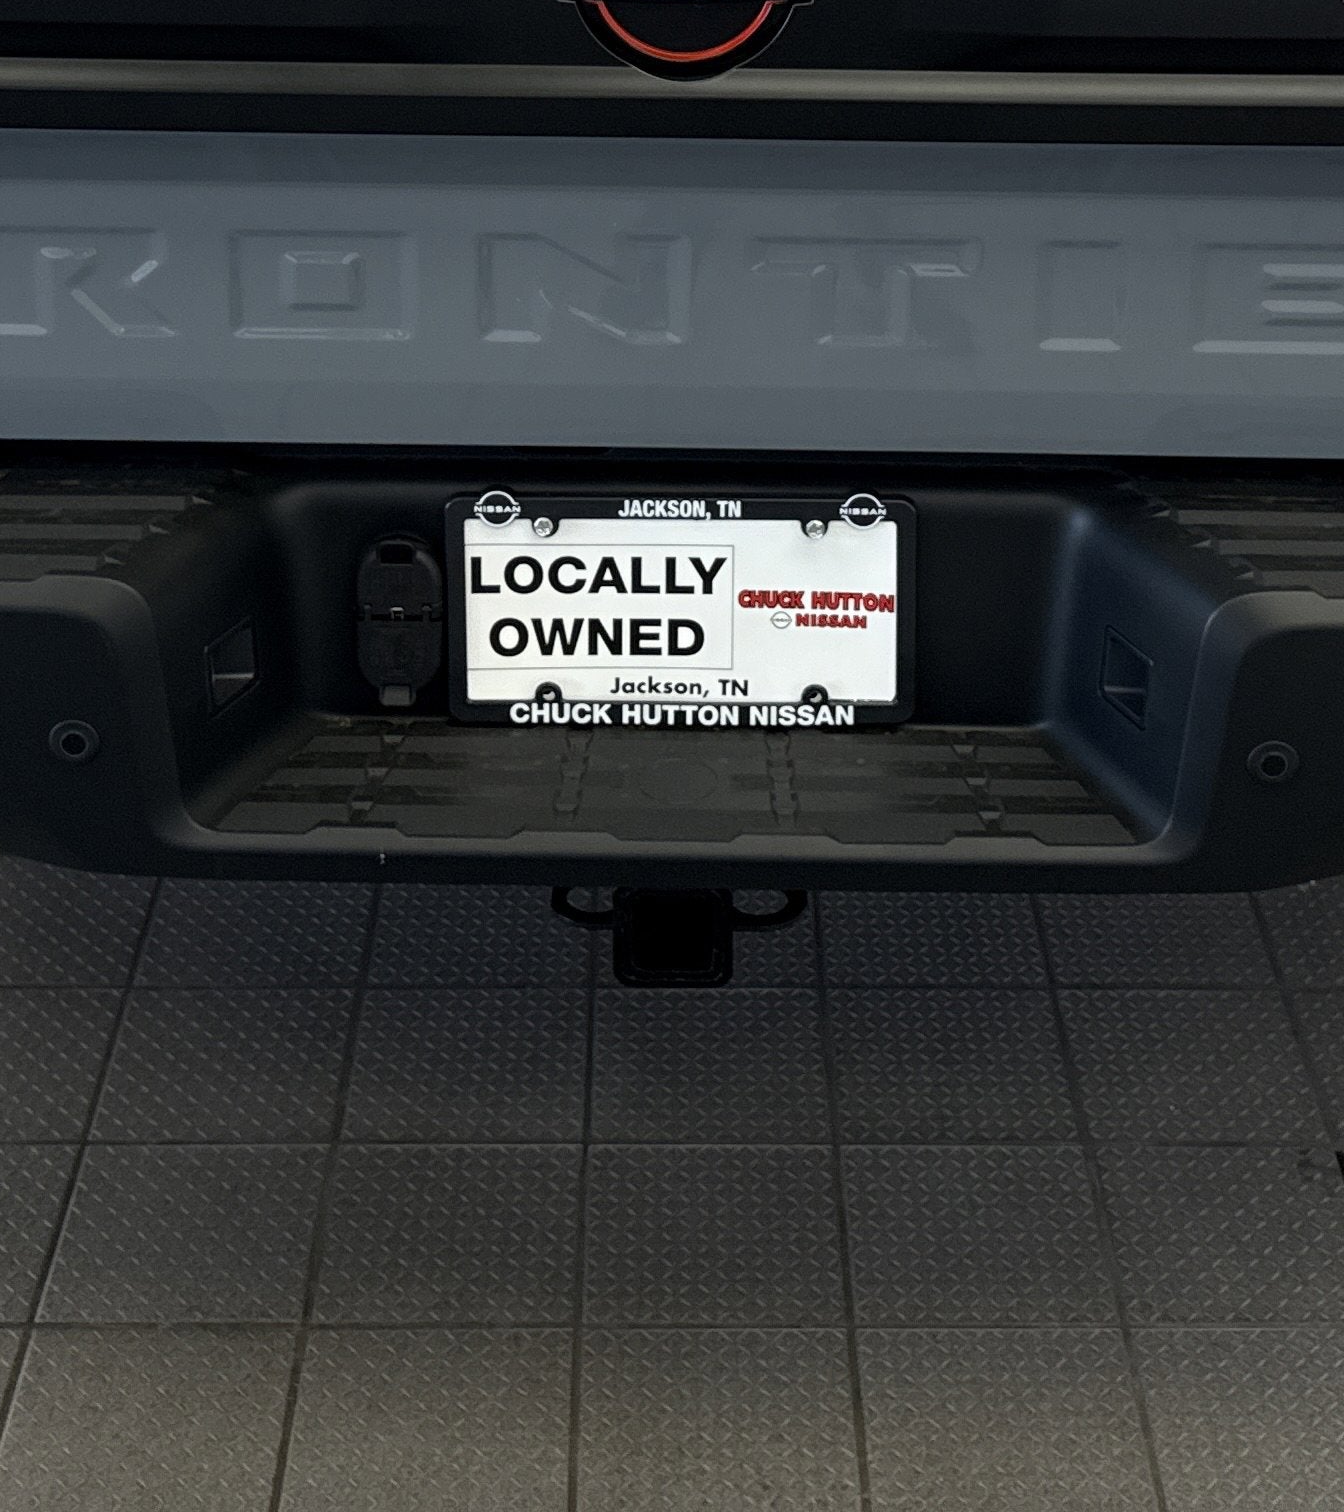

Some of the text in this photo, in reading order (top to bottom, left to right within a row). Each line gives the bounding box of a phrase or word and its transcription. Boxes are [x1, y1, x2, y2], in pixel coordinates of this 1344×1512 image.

[473, 505, 521, 513] NISSAN
[618, 500, 742, 519] JACKSON, TN
[839, 507, 887, 516] NISSAN
[470, 556, 728, 595] LOCALLY
[738, 589, 895, 613] CHUCK HUTTON
[795, 613, 867, 629] NISSAN
[488, 618, 705, 657] OWNED
[610, 677, 749, 697] Jackson, TN
[509, 703, 855, 725] CHUCK HUTTON NISSAN
